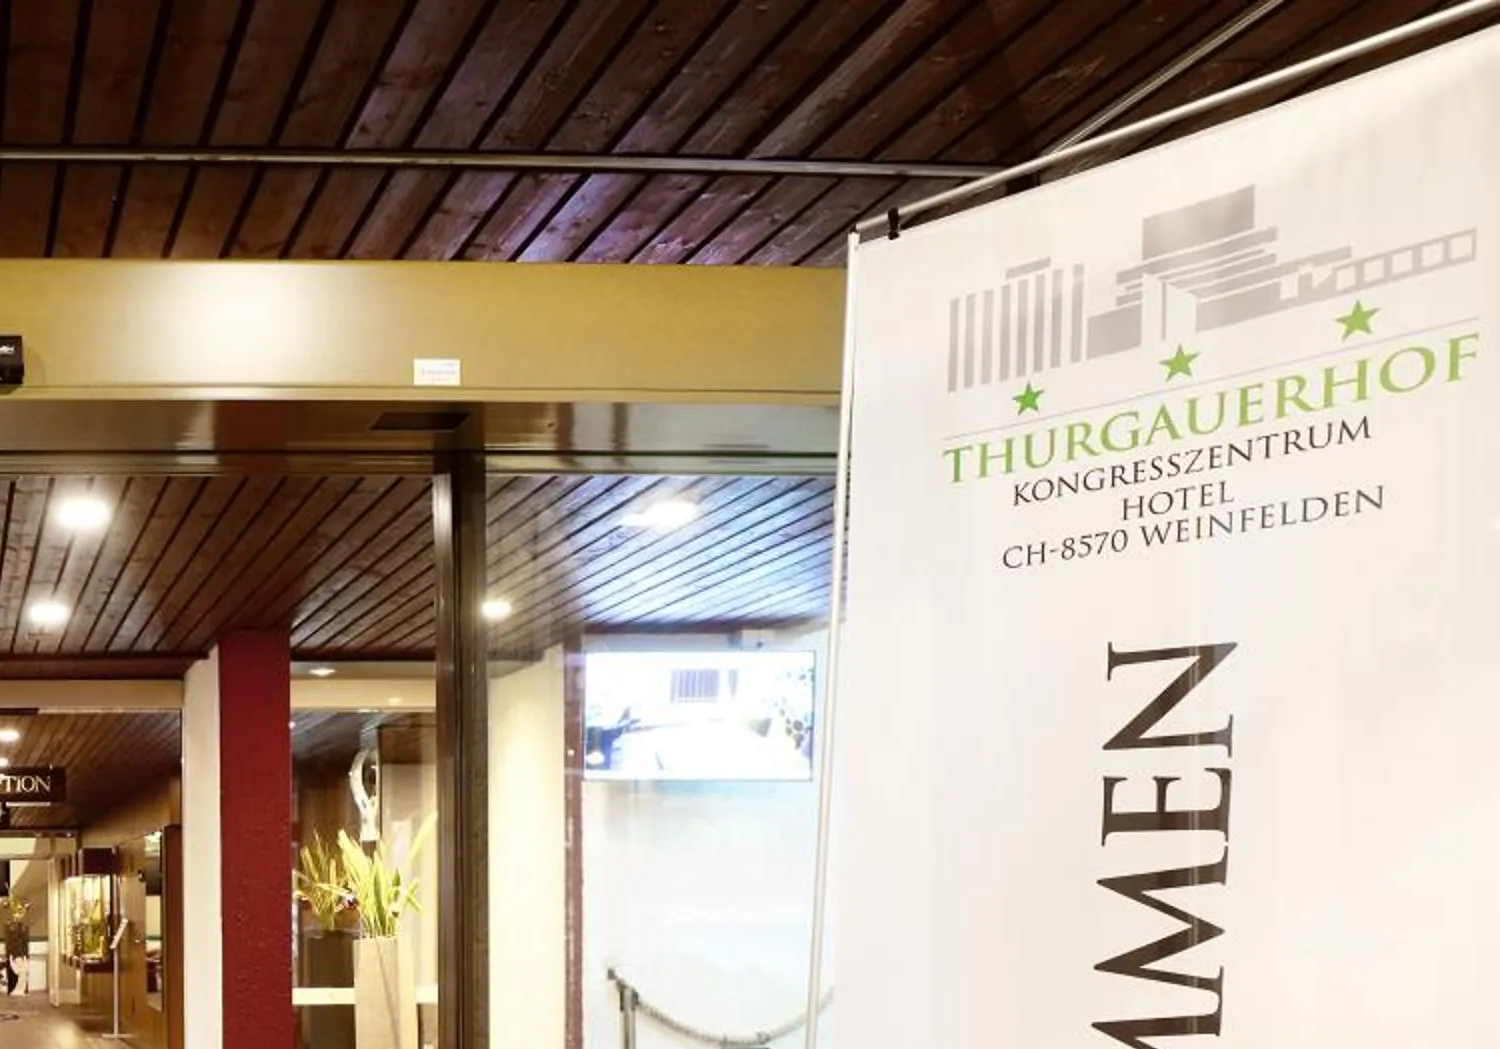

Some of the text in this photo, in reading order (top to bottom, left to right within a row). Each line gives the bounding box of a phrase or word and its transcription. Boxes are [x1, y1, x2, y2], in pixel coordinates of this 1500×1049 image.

[942, 333, 1480, 484] THURGAUERHOF
[1013, 415, 1371, 507] KONGRESSZENTRUM
[1122, 480, 1234, 521] HOTEL
[1002, 485, 1384, 569] CH-8570 WEINFELDEN
